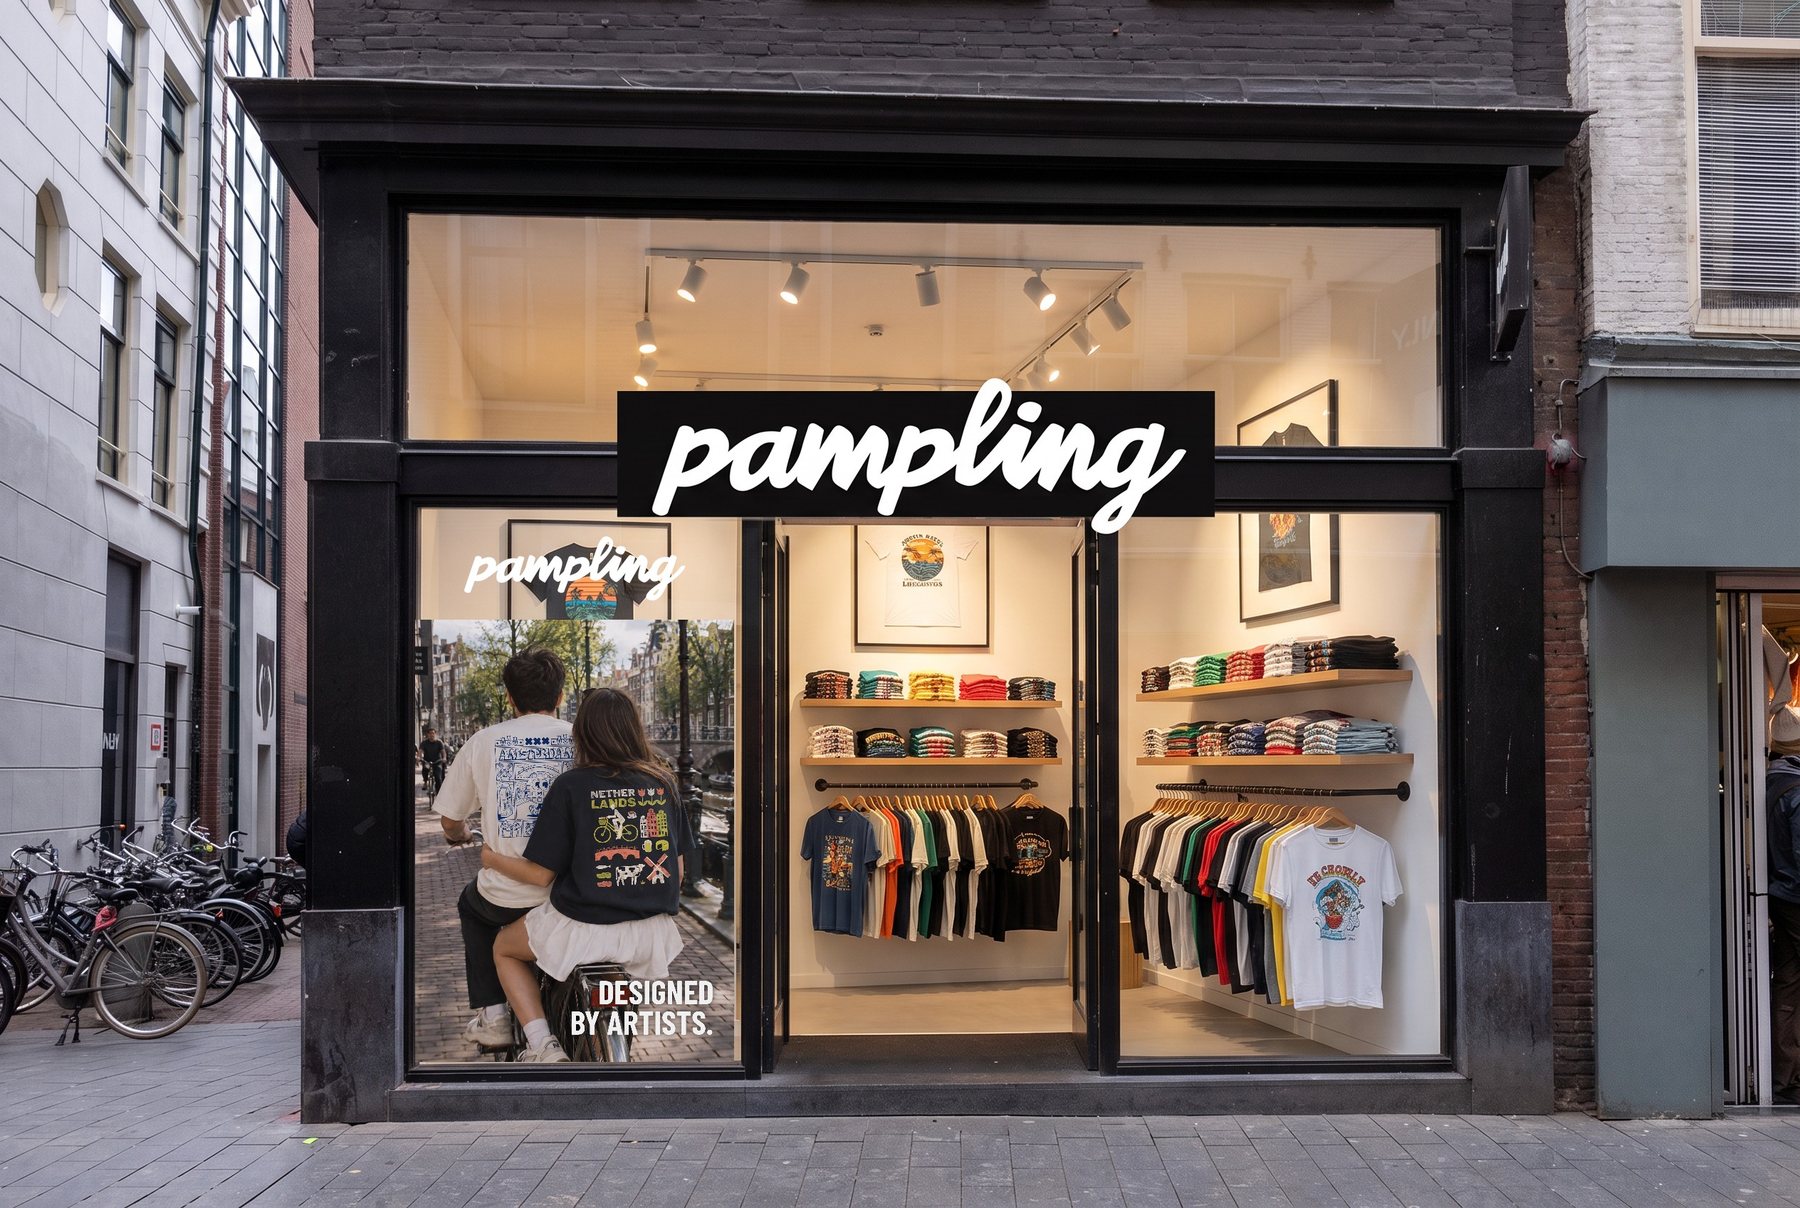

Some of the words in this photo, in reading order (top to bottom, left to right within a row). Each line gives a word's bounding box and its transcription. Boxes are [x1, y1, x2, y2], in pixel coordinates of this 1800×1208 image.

[651, 378, 1187, 536] pampling
[464, 536, 685, 601] pampling
[590, 788, 636, 799] NETHER
[591, 798, 637, 809] LANDS
[599, 980, 713, 1005] DESIGNED
[571, 1011, 600, 1036] BY
[607, 1011, 713, 1036] ARTISTS.
